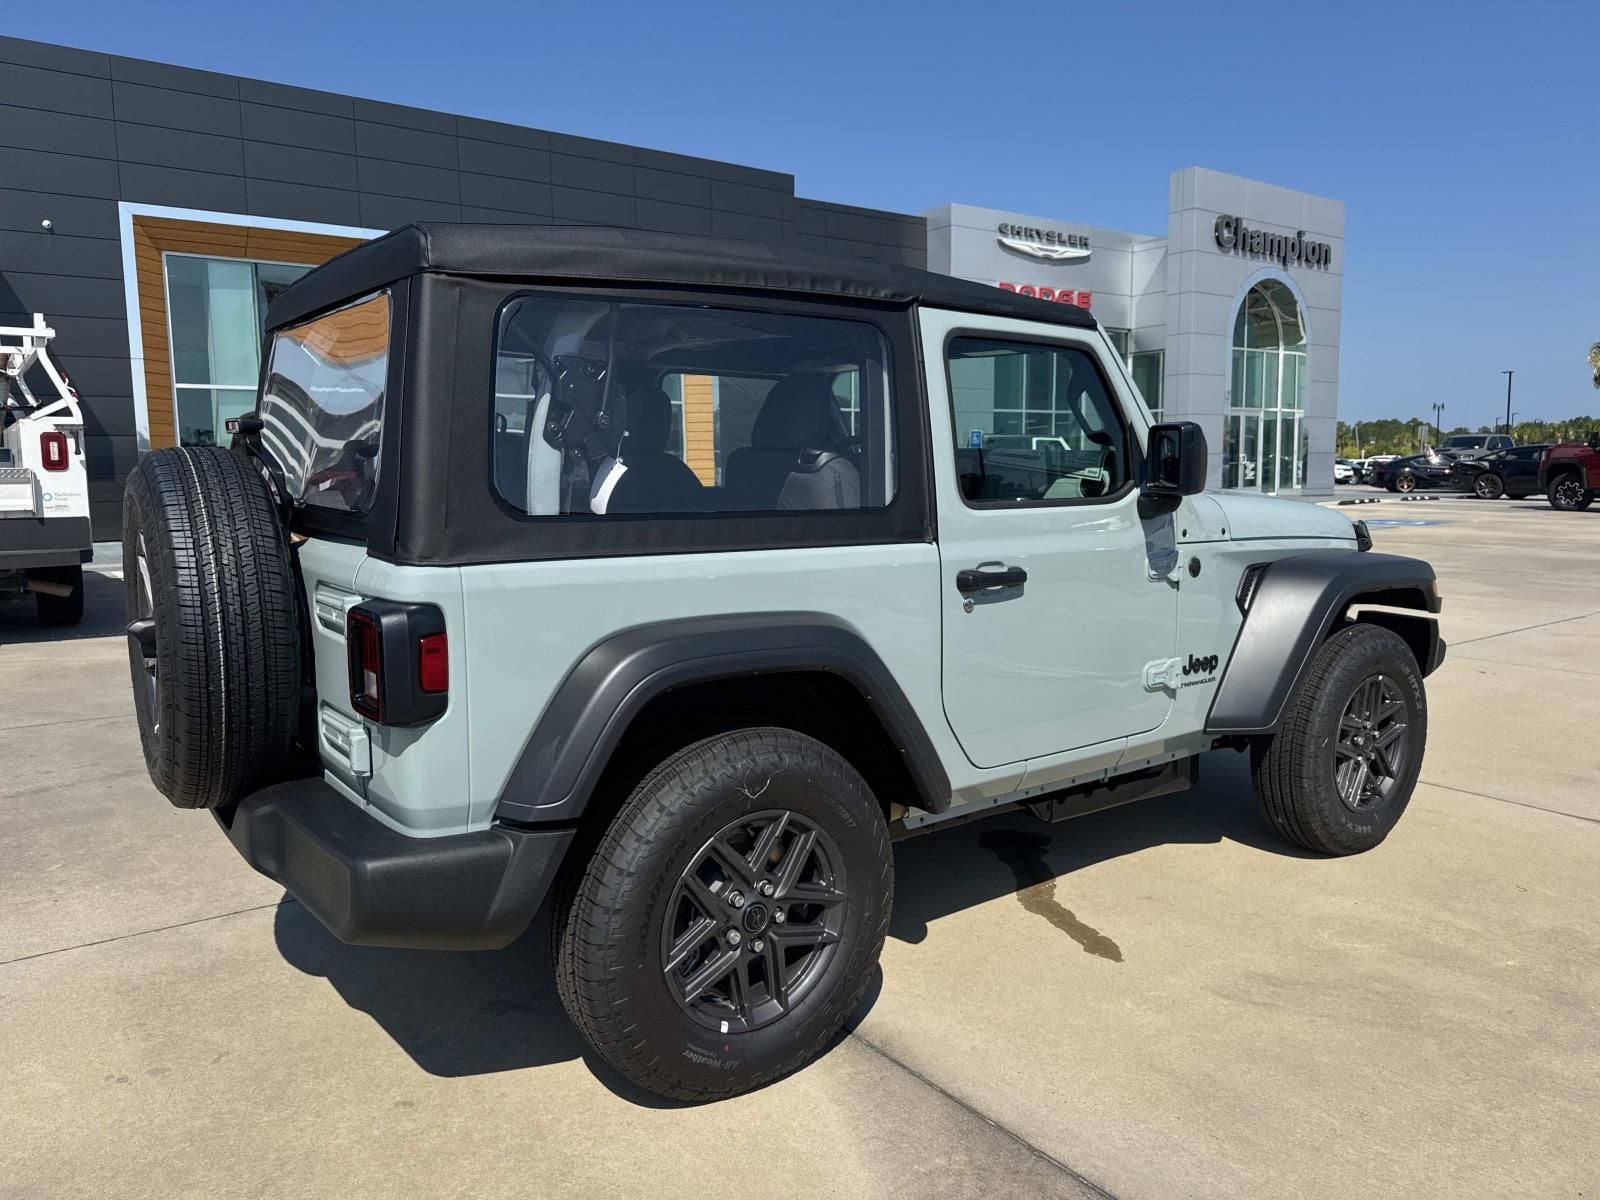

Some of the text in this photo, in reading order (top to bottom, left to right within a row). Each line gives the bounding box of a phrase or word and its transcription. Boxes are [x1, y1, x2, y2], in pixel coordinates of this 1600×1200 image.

[998, 223, 1090, 247] CHRYSLER
[1215, 214, 1332, 271] Champion
[1182, 654, 1218, 675] Jeep
[1183, 677, 1216, 687] WRANGLER
[681, 1049, 740, 1069] All-Weather
